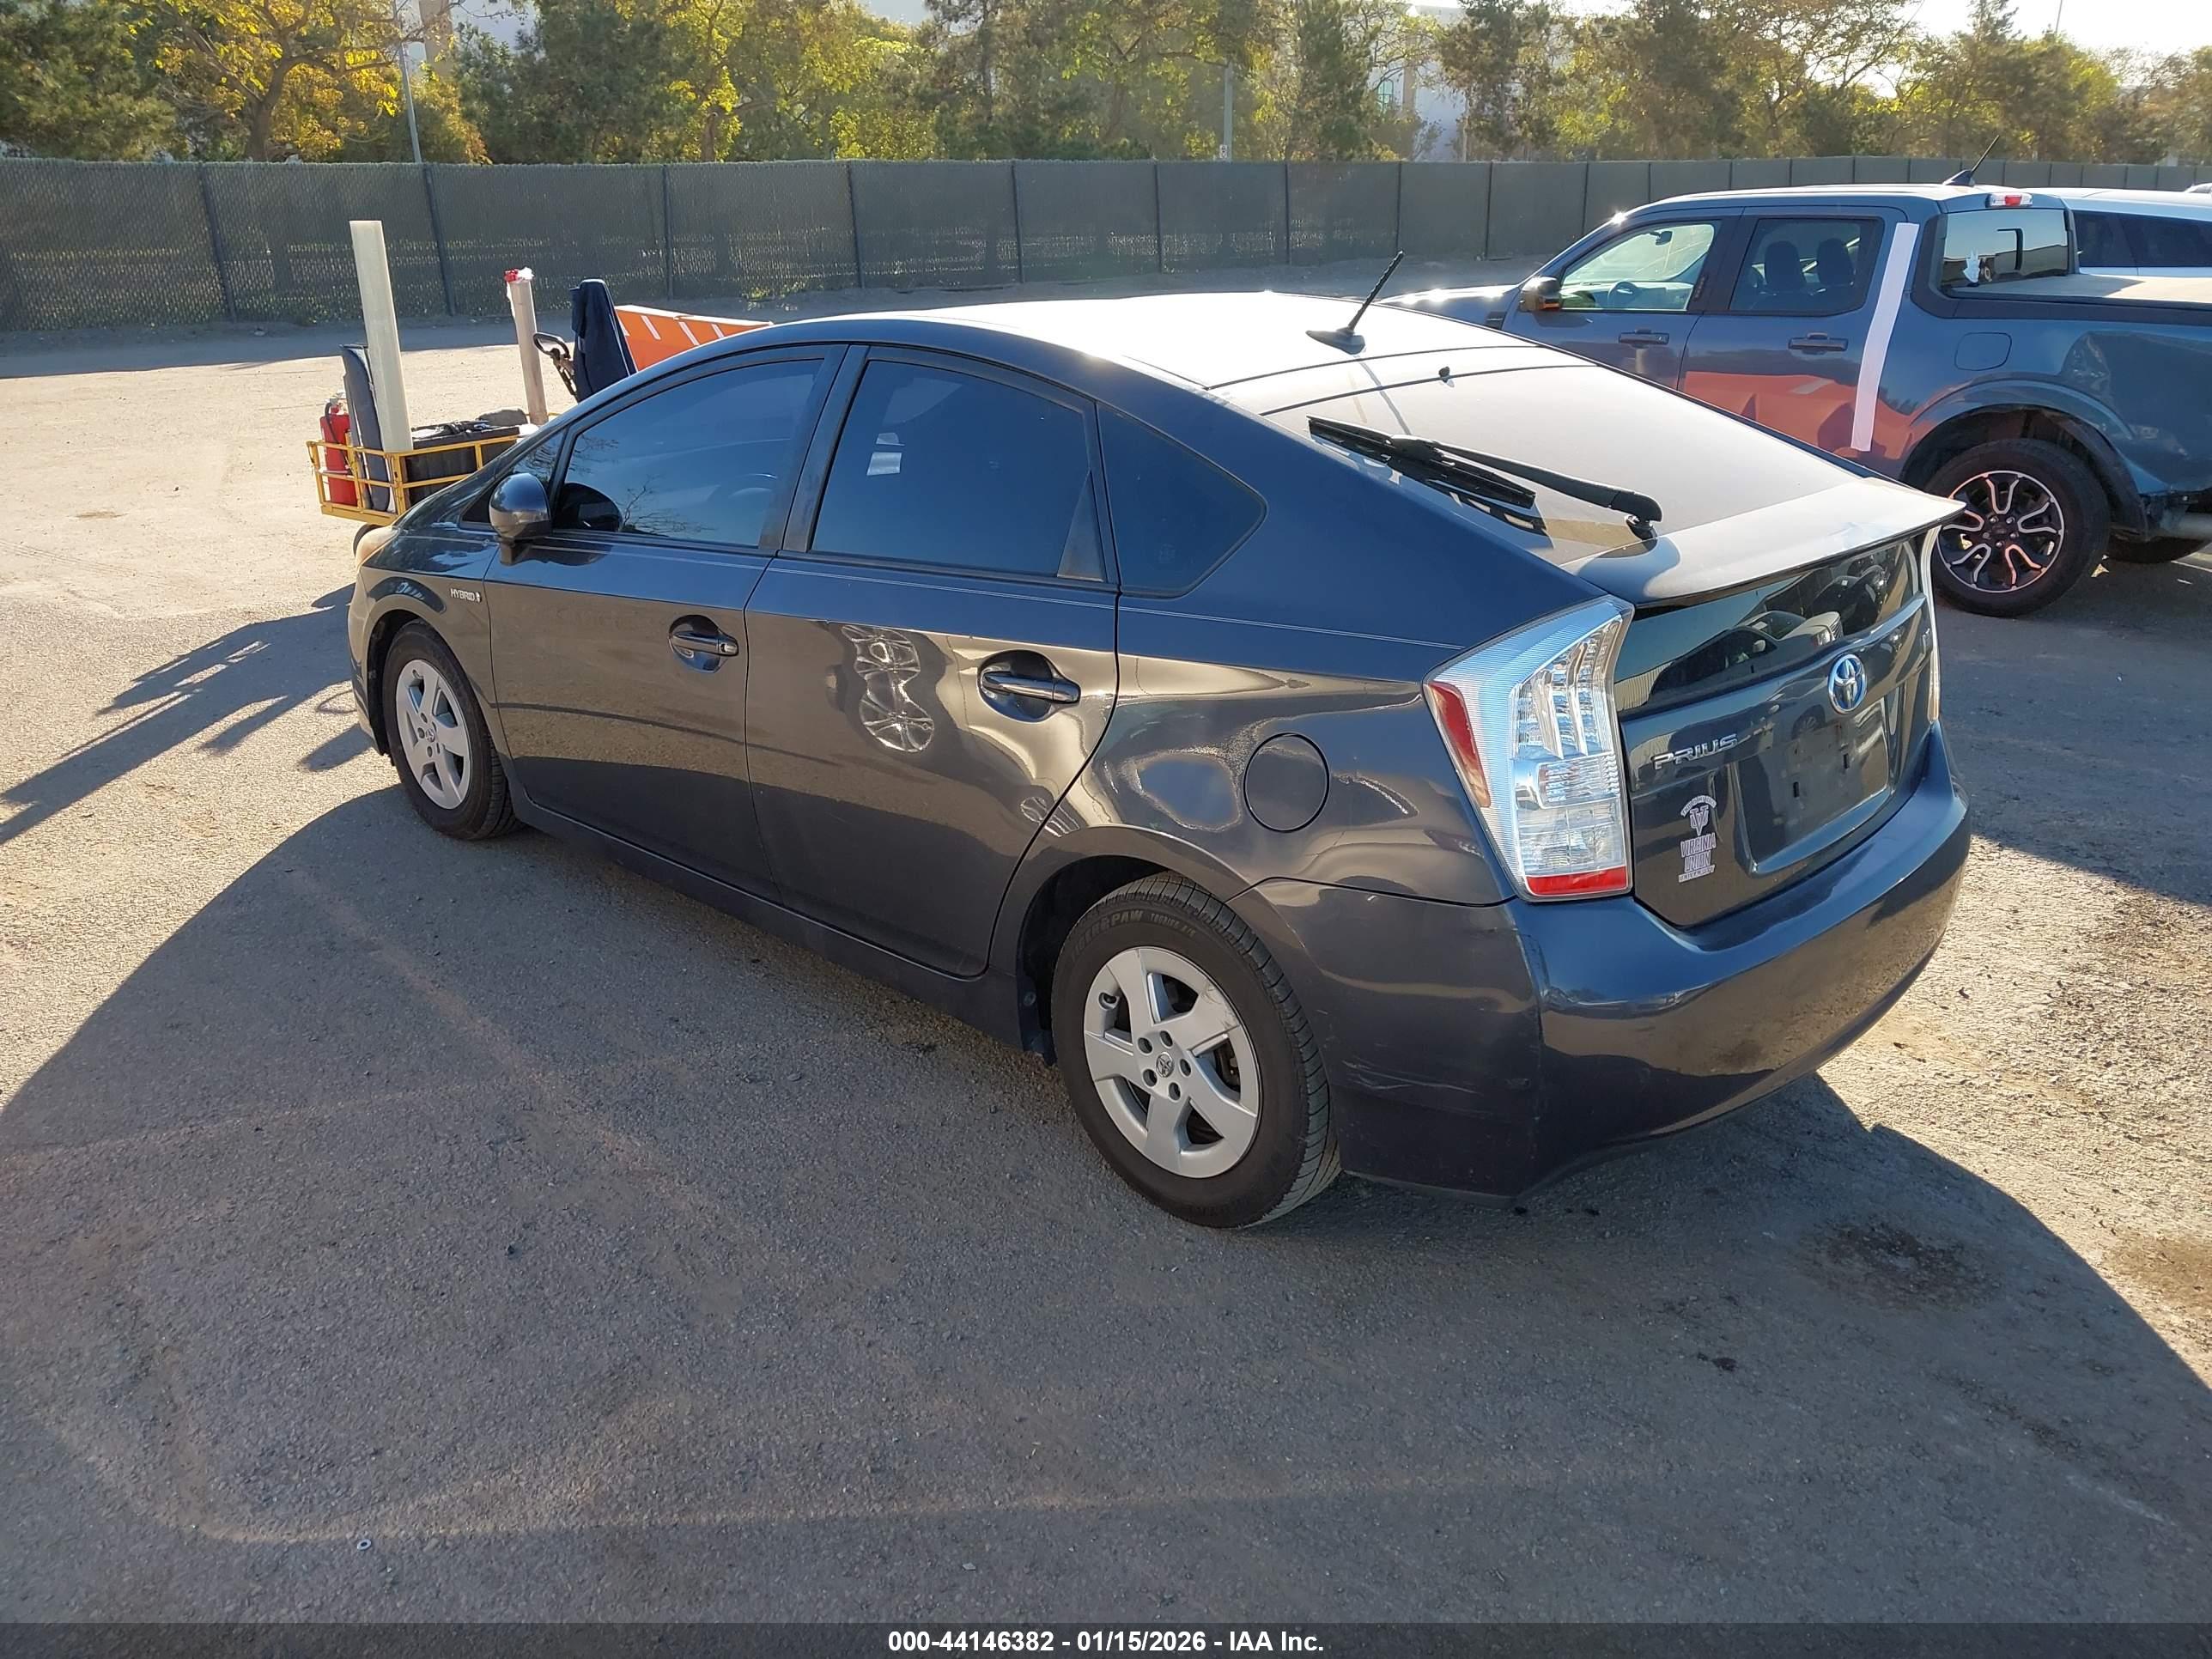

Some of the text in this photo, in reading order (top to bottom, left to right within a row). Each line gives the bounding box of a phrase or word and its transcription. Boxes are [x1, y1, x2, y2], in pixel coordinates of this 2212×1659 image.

[450, 587, 476, 602] HYBRID
[1653, 733, 1738, 769] PRIUS
[1680, 832, 1717, 858] VIRGINIA
[1684, 850, 1711, 872] UNION
[1110, 909, 1144, 927] PAW
